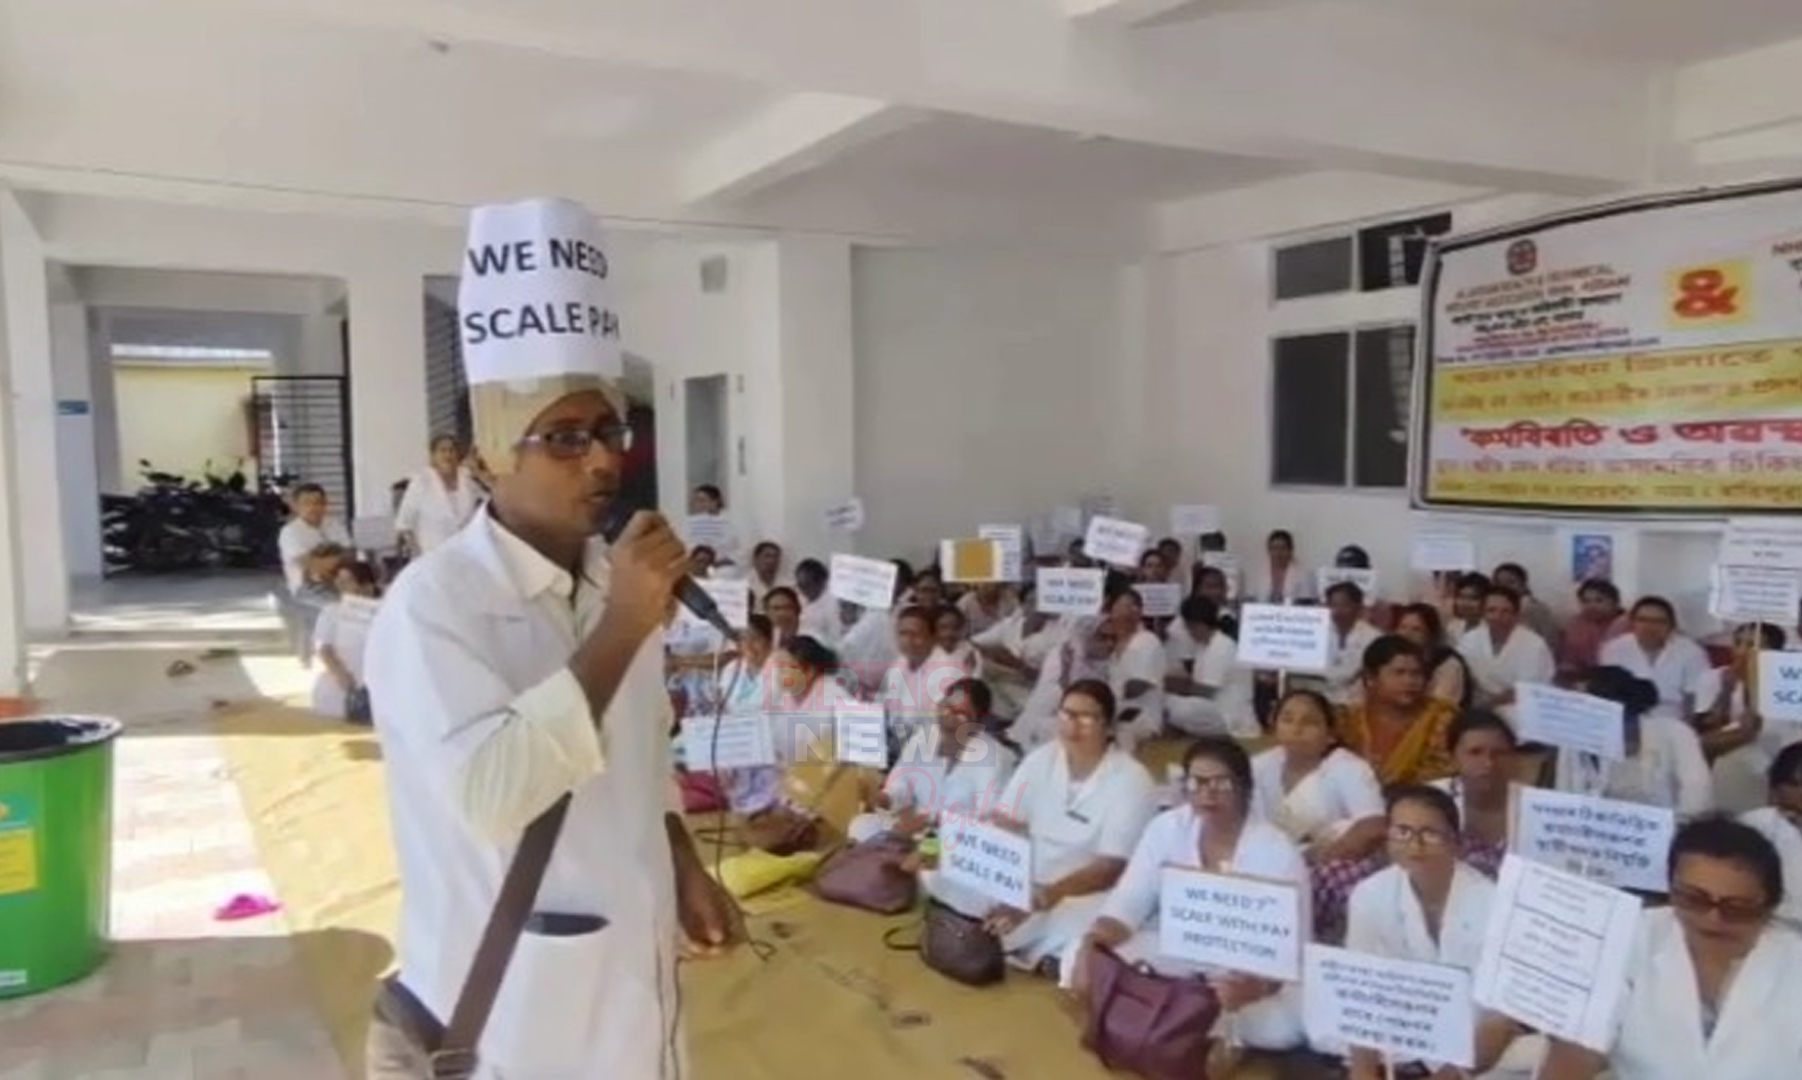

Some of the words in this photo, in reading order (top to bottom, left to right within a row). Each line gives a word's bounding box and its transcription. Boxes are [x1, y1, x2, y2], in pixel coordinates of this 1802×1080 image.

[468, 240, 537, 275] WE
[549, 238, 609, 280] NEED
[1673, 268, 1740, 318] &
[464, 302, 585, 344] SCALE
[1773, 690, 1802, 705] SC
[981, 839, 1021, 867] NEED
[950, 853, 991, 879] SCALE
[994, 870, 1024, 892] PAY
[1185, 886, 1207, 901] WE
[1212, 891, 1252, 910] NEED
[1170, 905, 1212, 922] SCALE
[1218, 914, 1257, 932] WITH
[1183, 930, 1277, 958] PROTECTION
